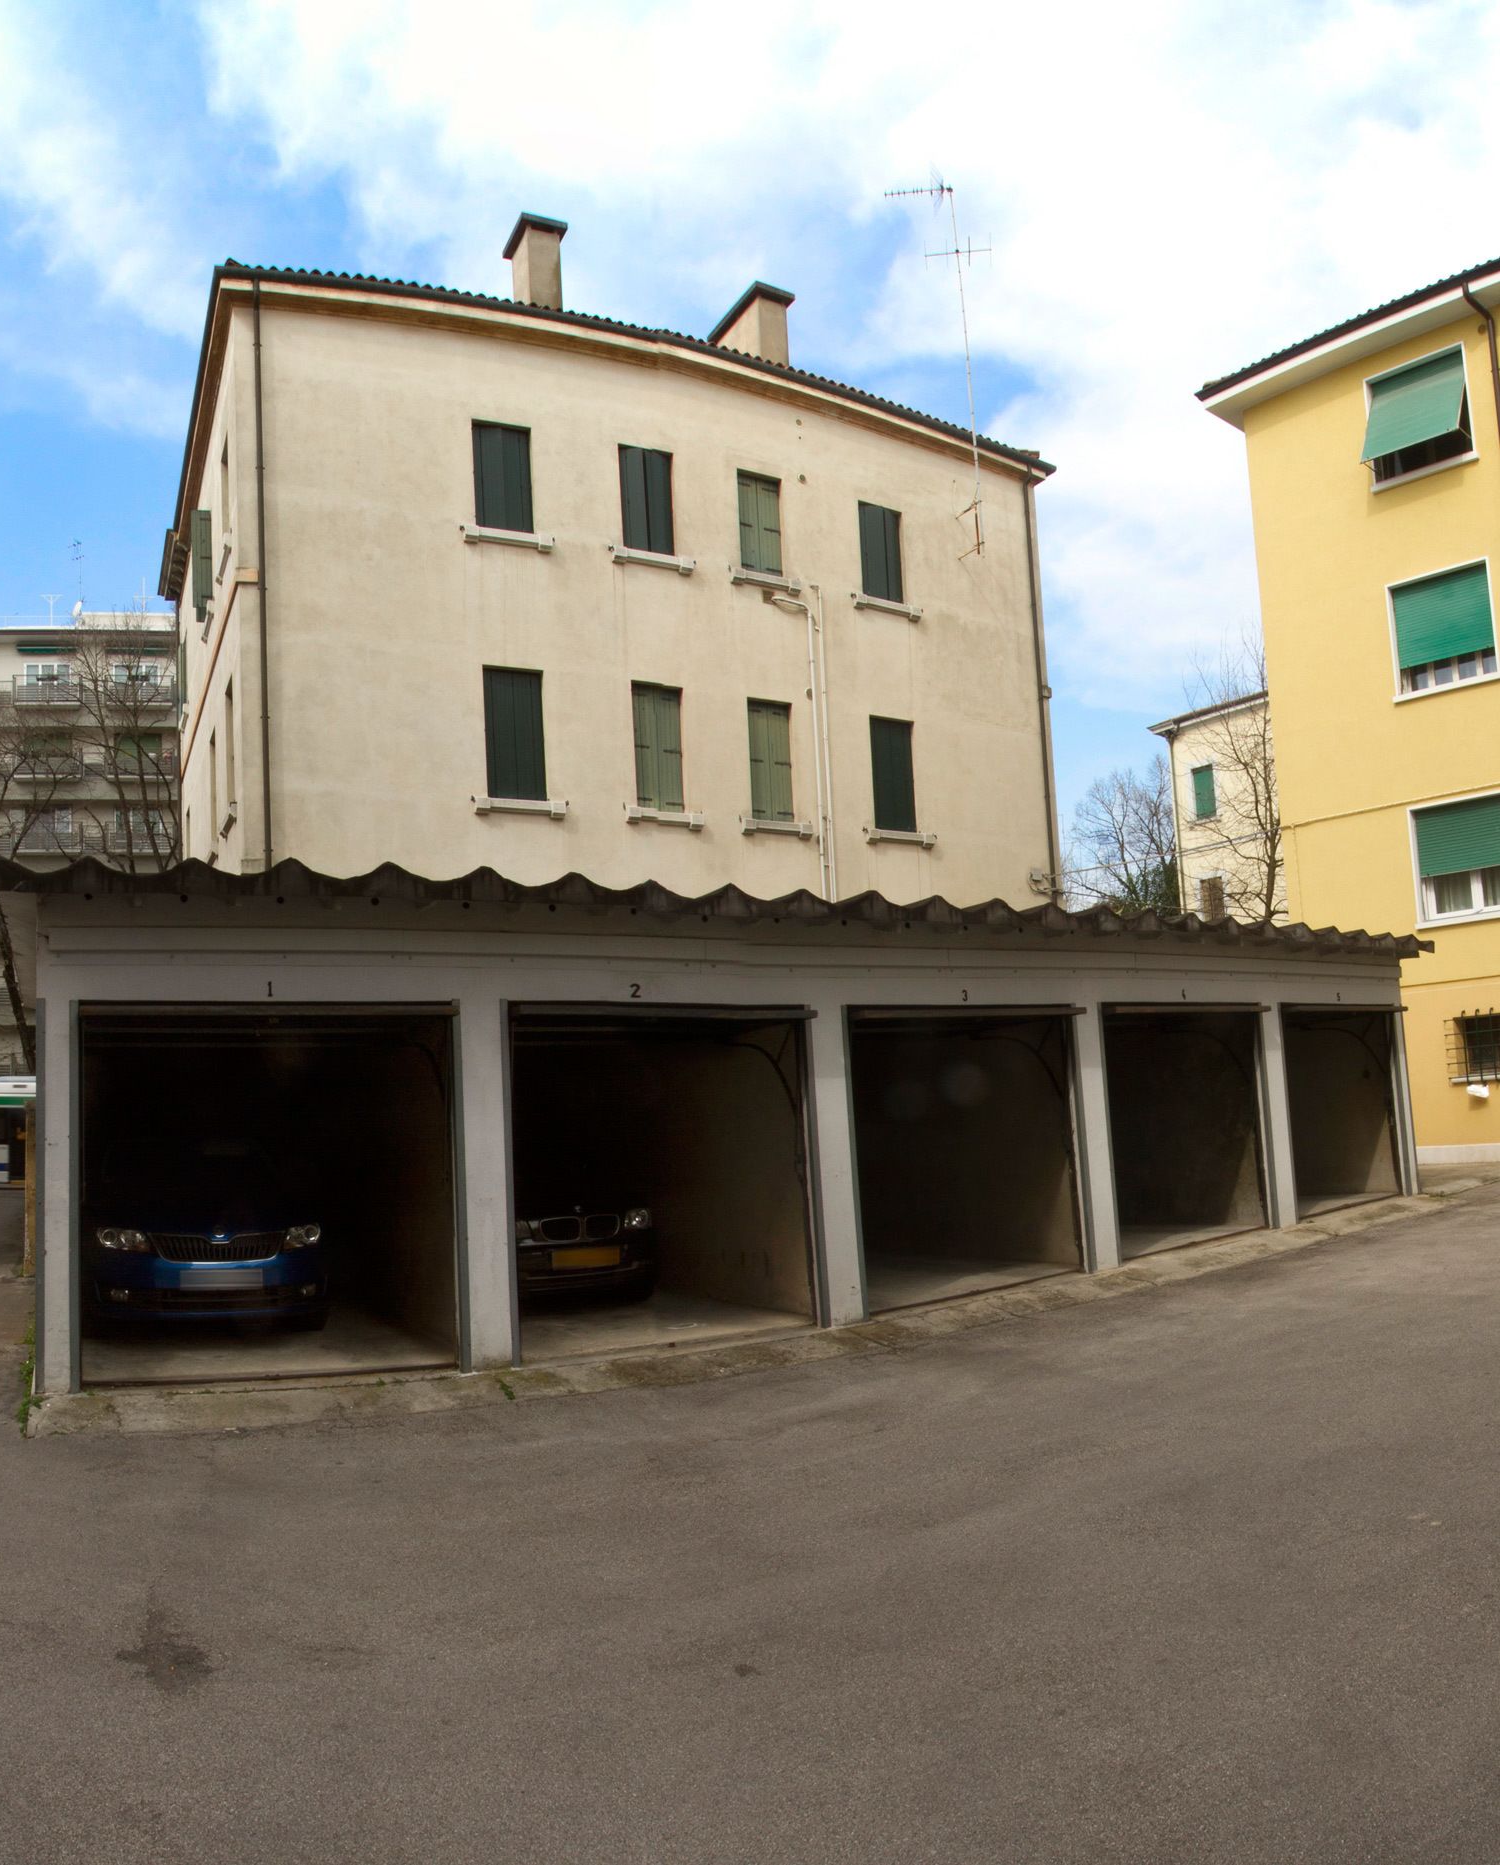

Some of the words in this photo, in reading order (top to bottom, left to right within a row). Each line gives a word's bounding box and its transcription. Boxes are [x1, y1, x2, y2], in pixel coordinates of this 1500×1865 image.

[267, 981, 273, 997] 1
[629, 983, 641, 998] 2
[962, 989, 968, 1002] 3
